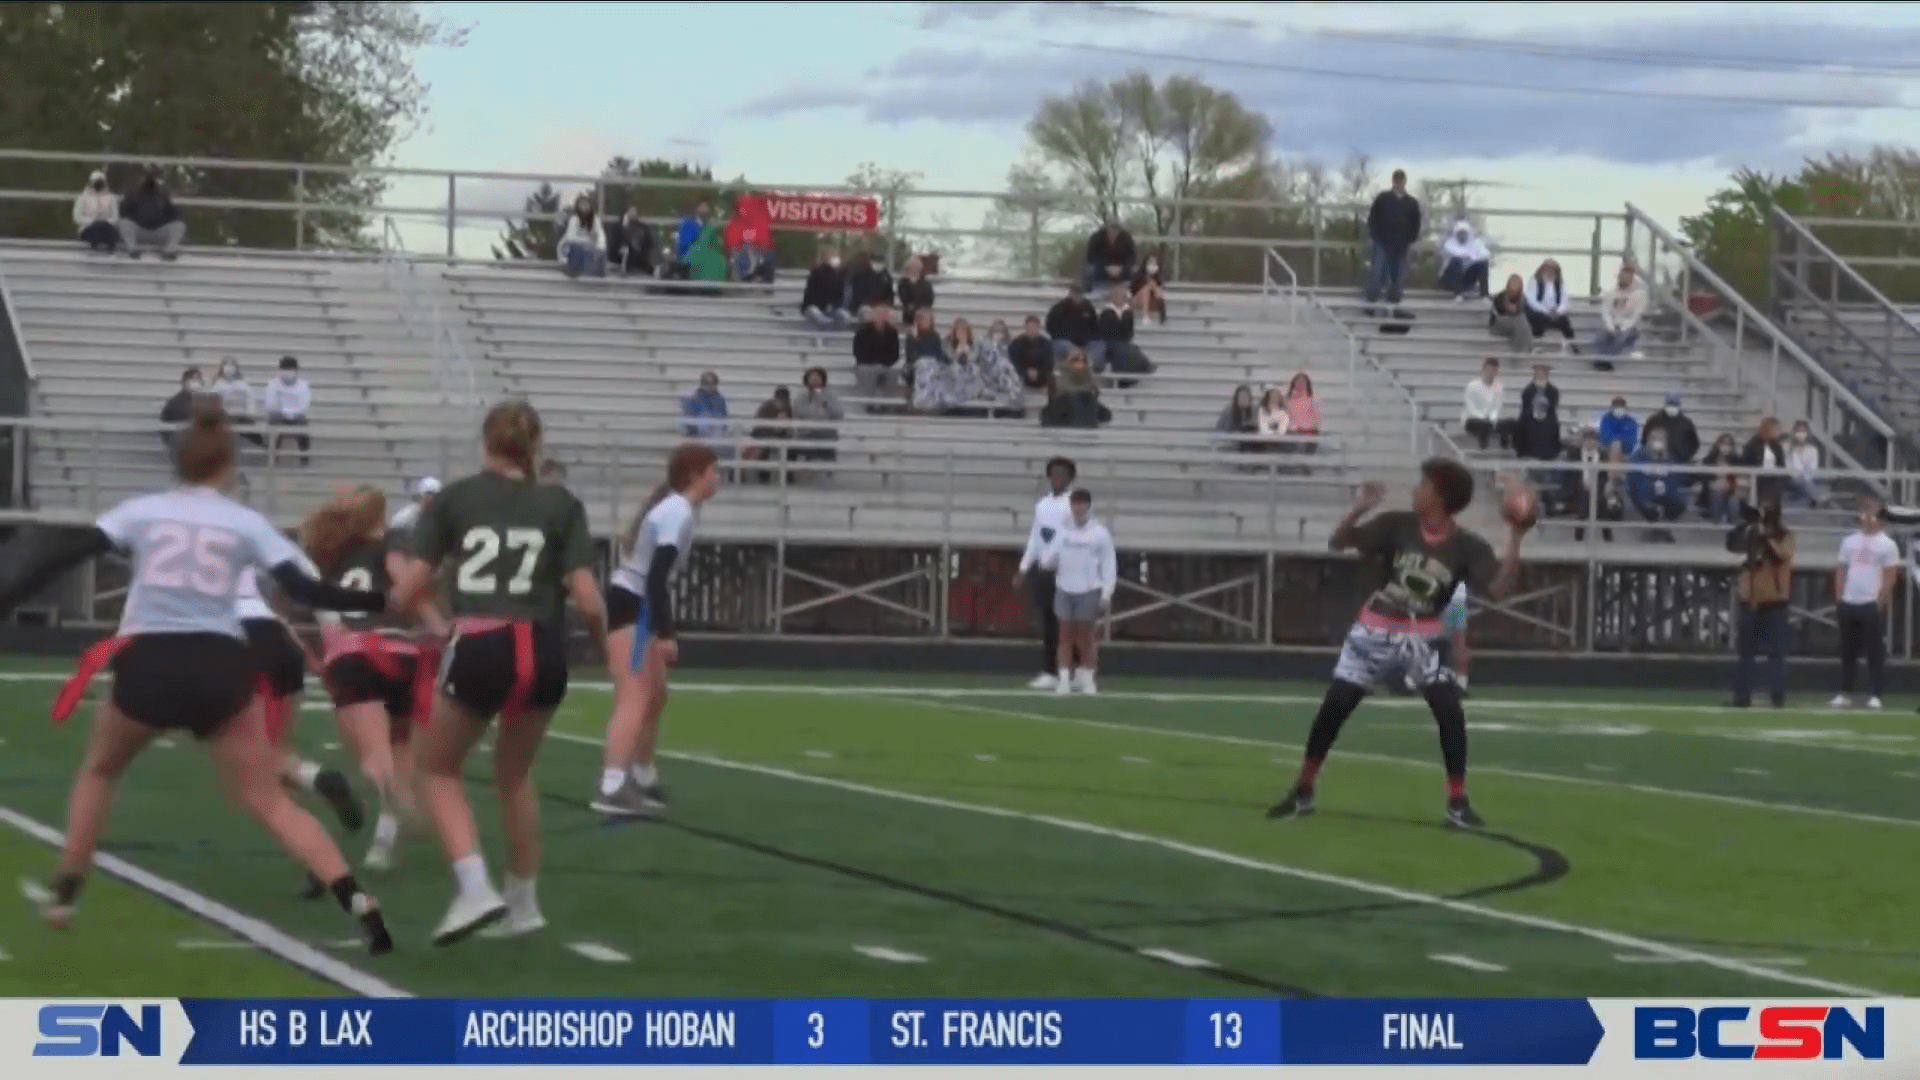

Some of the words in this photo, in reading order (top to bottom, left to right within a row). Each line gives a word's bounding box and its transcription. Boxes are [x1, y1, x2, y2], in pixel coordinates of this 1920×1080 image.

[767, 199, 868, 223] VISITORS
[145, 522, 236, 595] 25
[458, 525, 546, 594] 27
